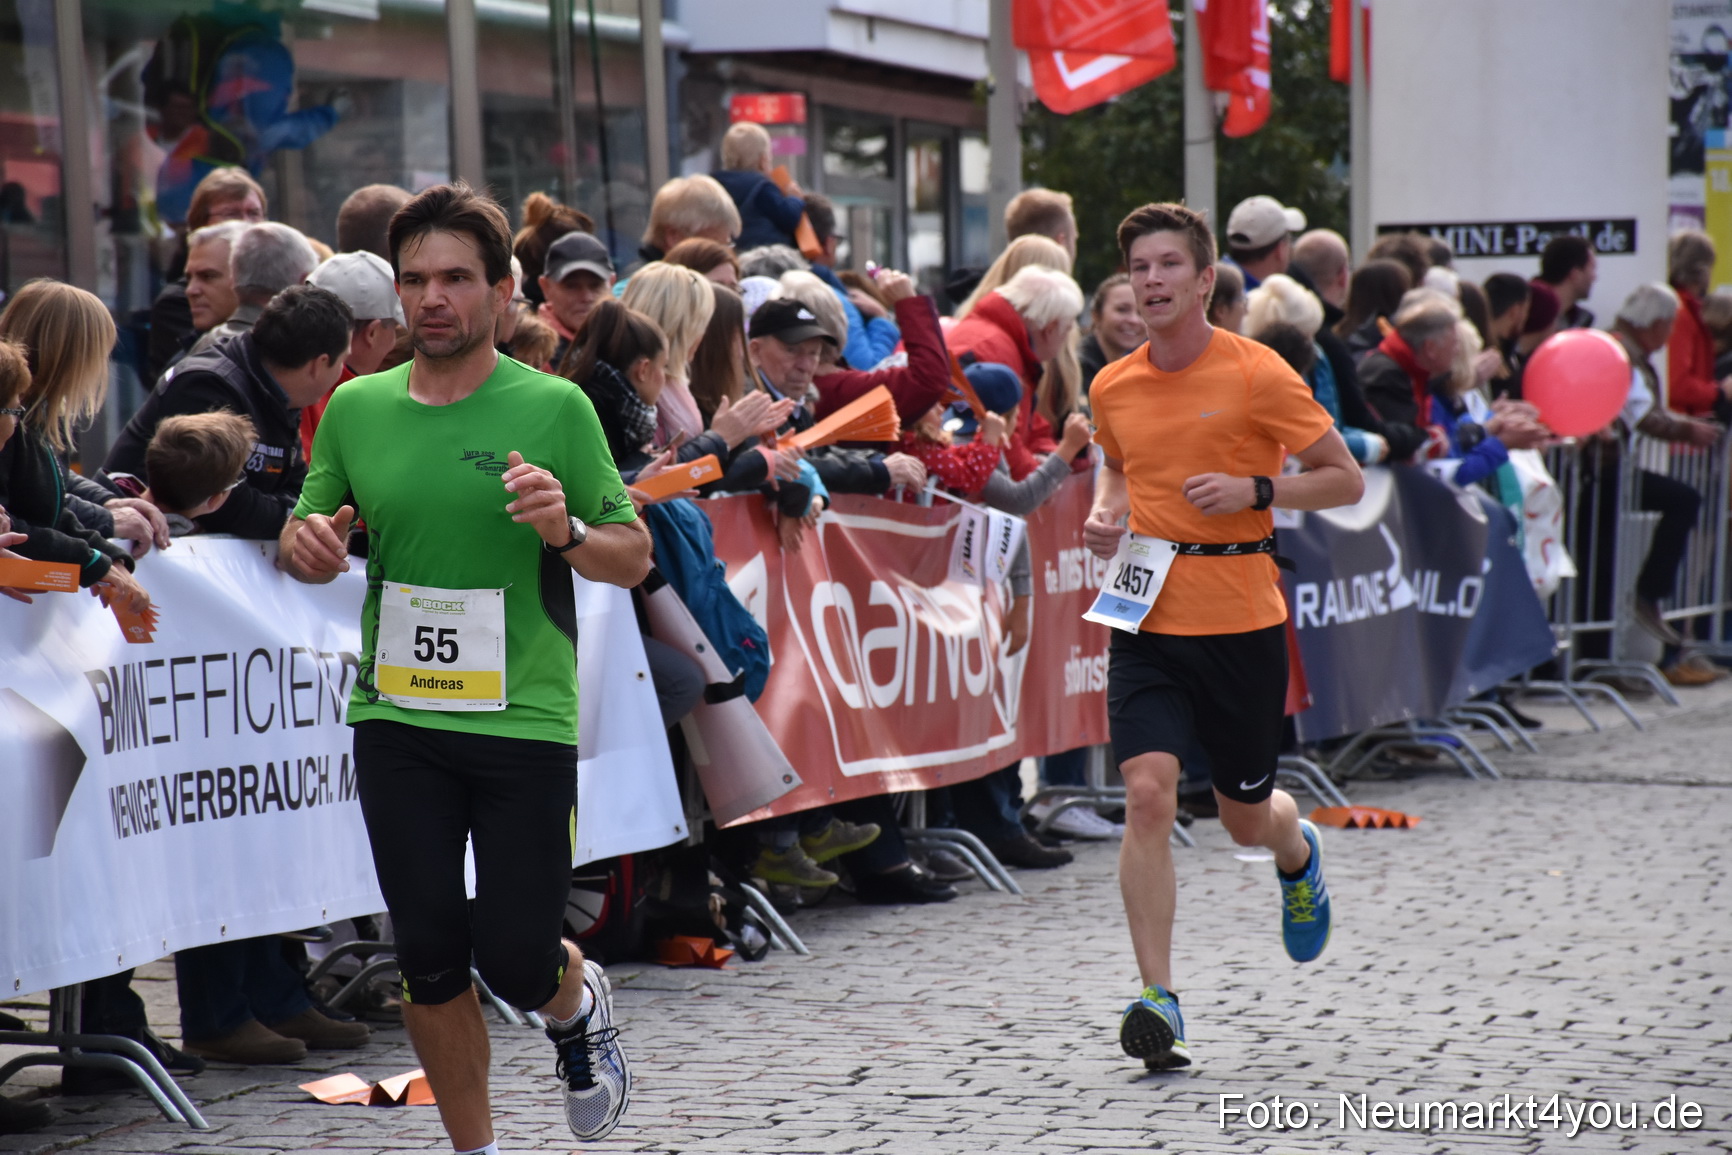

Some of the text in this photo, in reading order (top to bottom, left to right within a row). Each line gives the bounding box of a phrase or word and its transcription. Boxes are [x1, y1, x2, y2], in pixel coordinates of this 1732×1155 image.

[1113, 562, 1155, 598] 2457
[421, 598, 465, 612] BOCK
[414, 625, 459, 664] 55
[409, 674, 464, 690] Andreas
[160, 754, 334, 827] VERBRAUCH.
